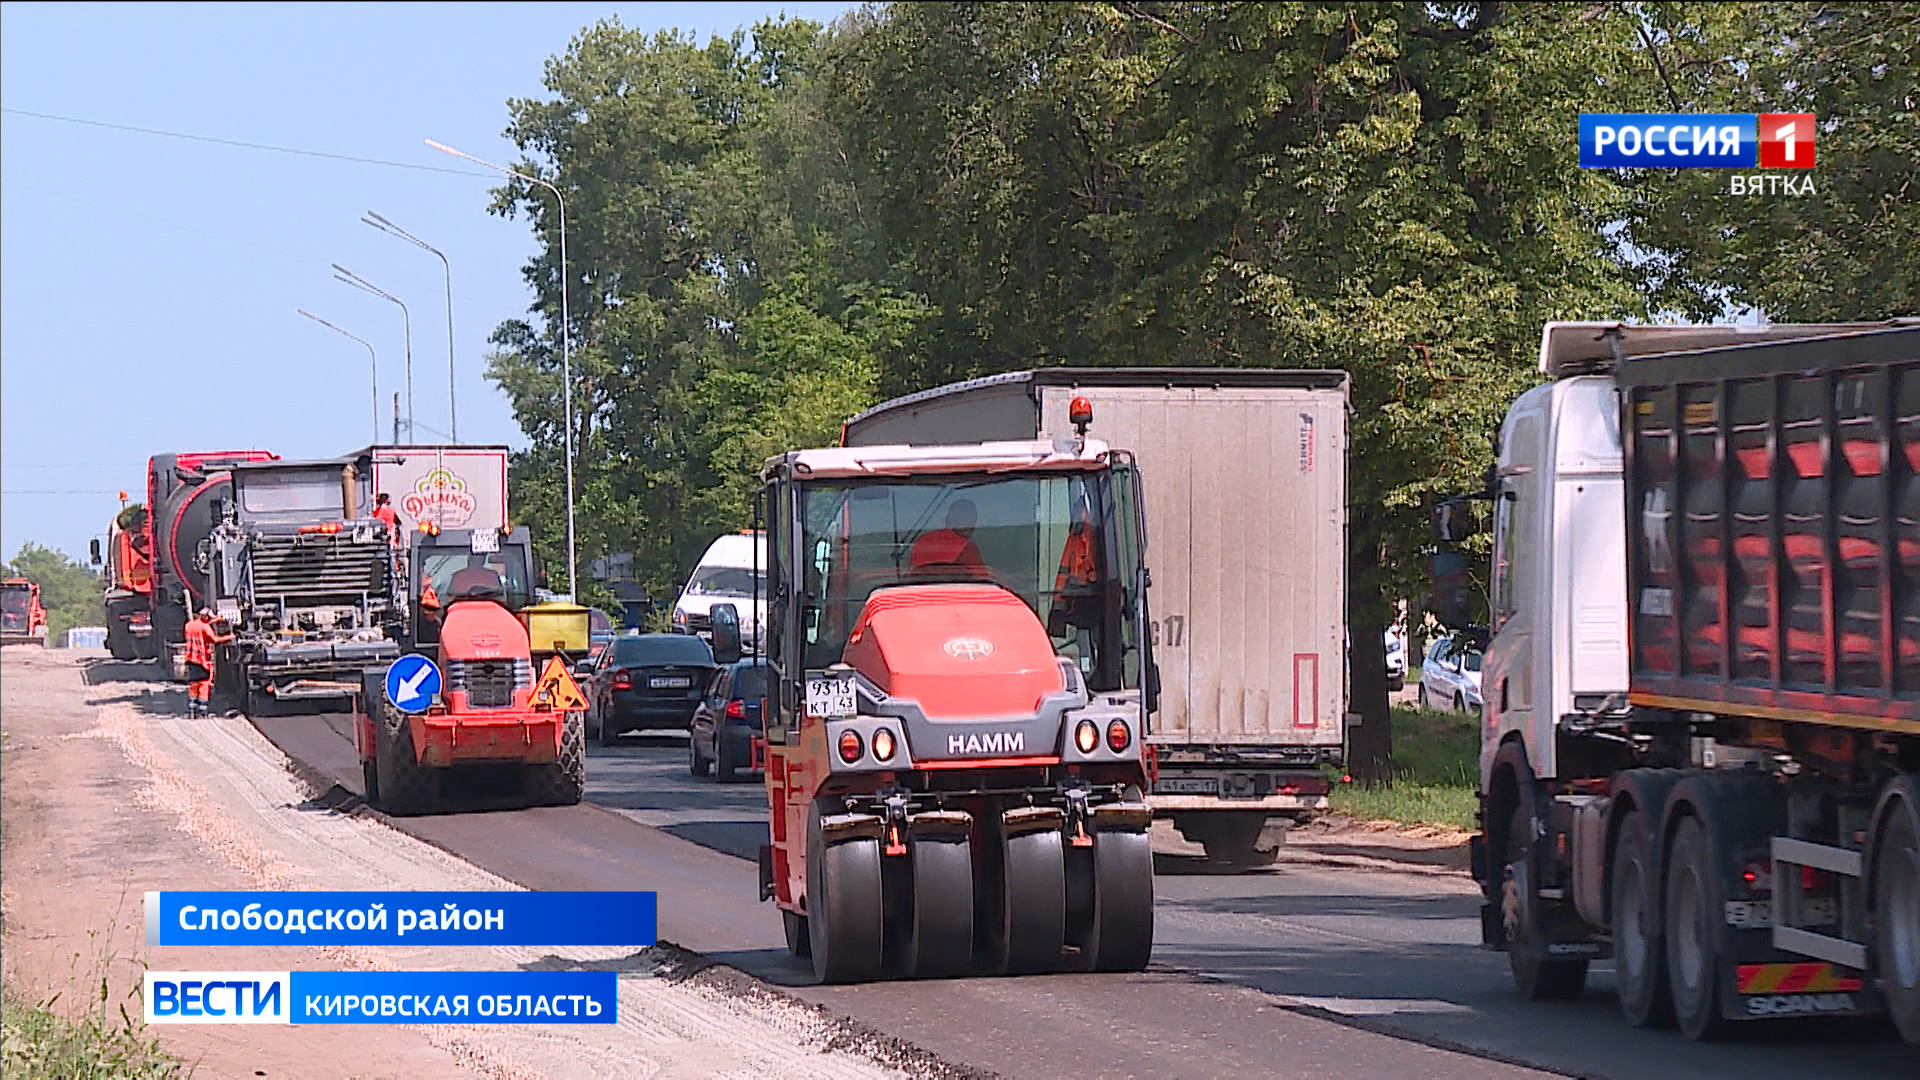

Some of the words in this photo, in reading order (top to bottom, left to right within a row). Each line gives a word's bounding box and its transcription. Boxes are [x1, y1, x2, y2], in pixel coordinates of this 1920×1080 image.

[1164, 615, 1184, 647] 17
[812, 681, 850, 696] 9313
[948, 732, 1025, 754] HAMM
